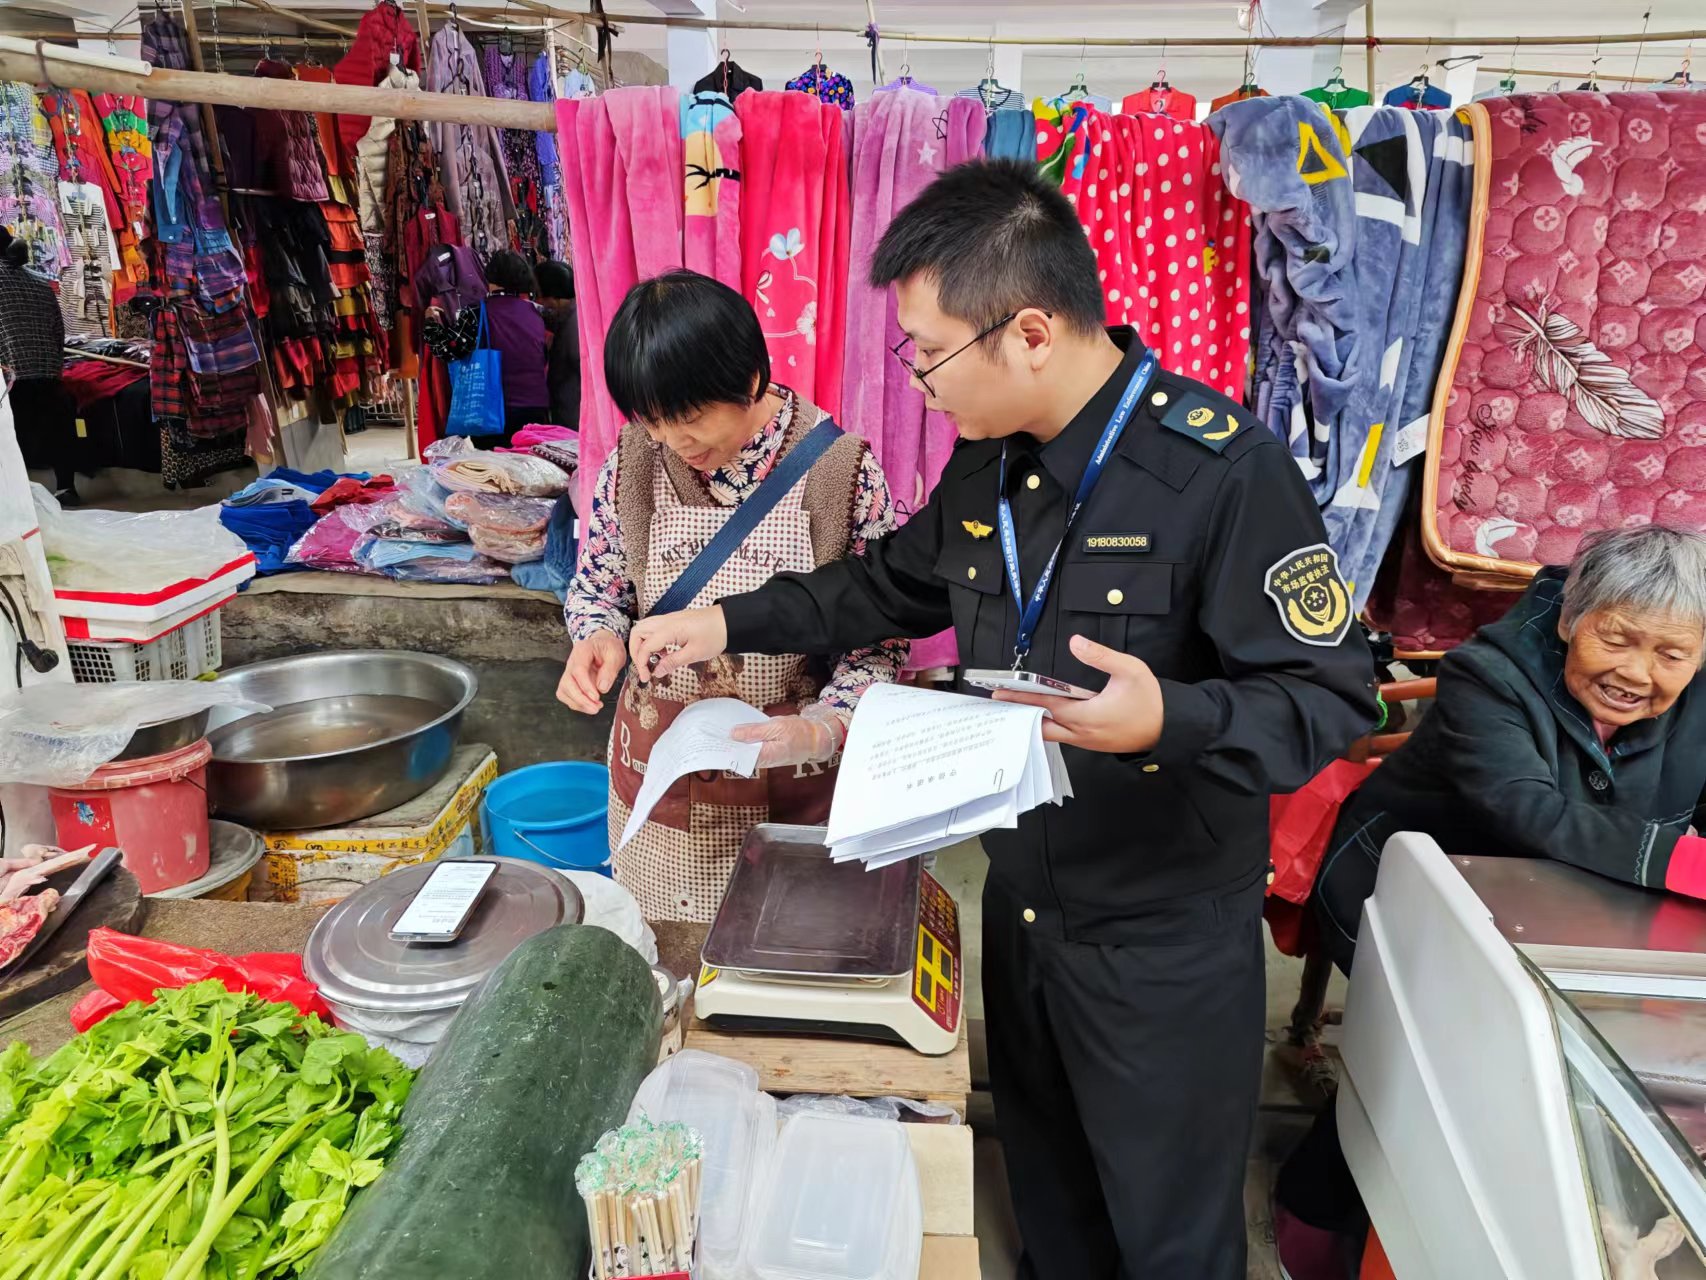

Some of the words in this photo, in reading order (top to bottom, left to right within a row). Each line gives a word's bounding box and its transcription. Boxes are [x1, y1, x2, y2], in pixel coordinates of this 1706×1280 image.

[1115, 410, 1126, 424] Law
[1087, 536, 1147, 548] 19180830058
[1273, 553, 1329, 587] 中华人民共和国
